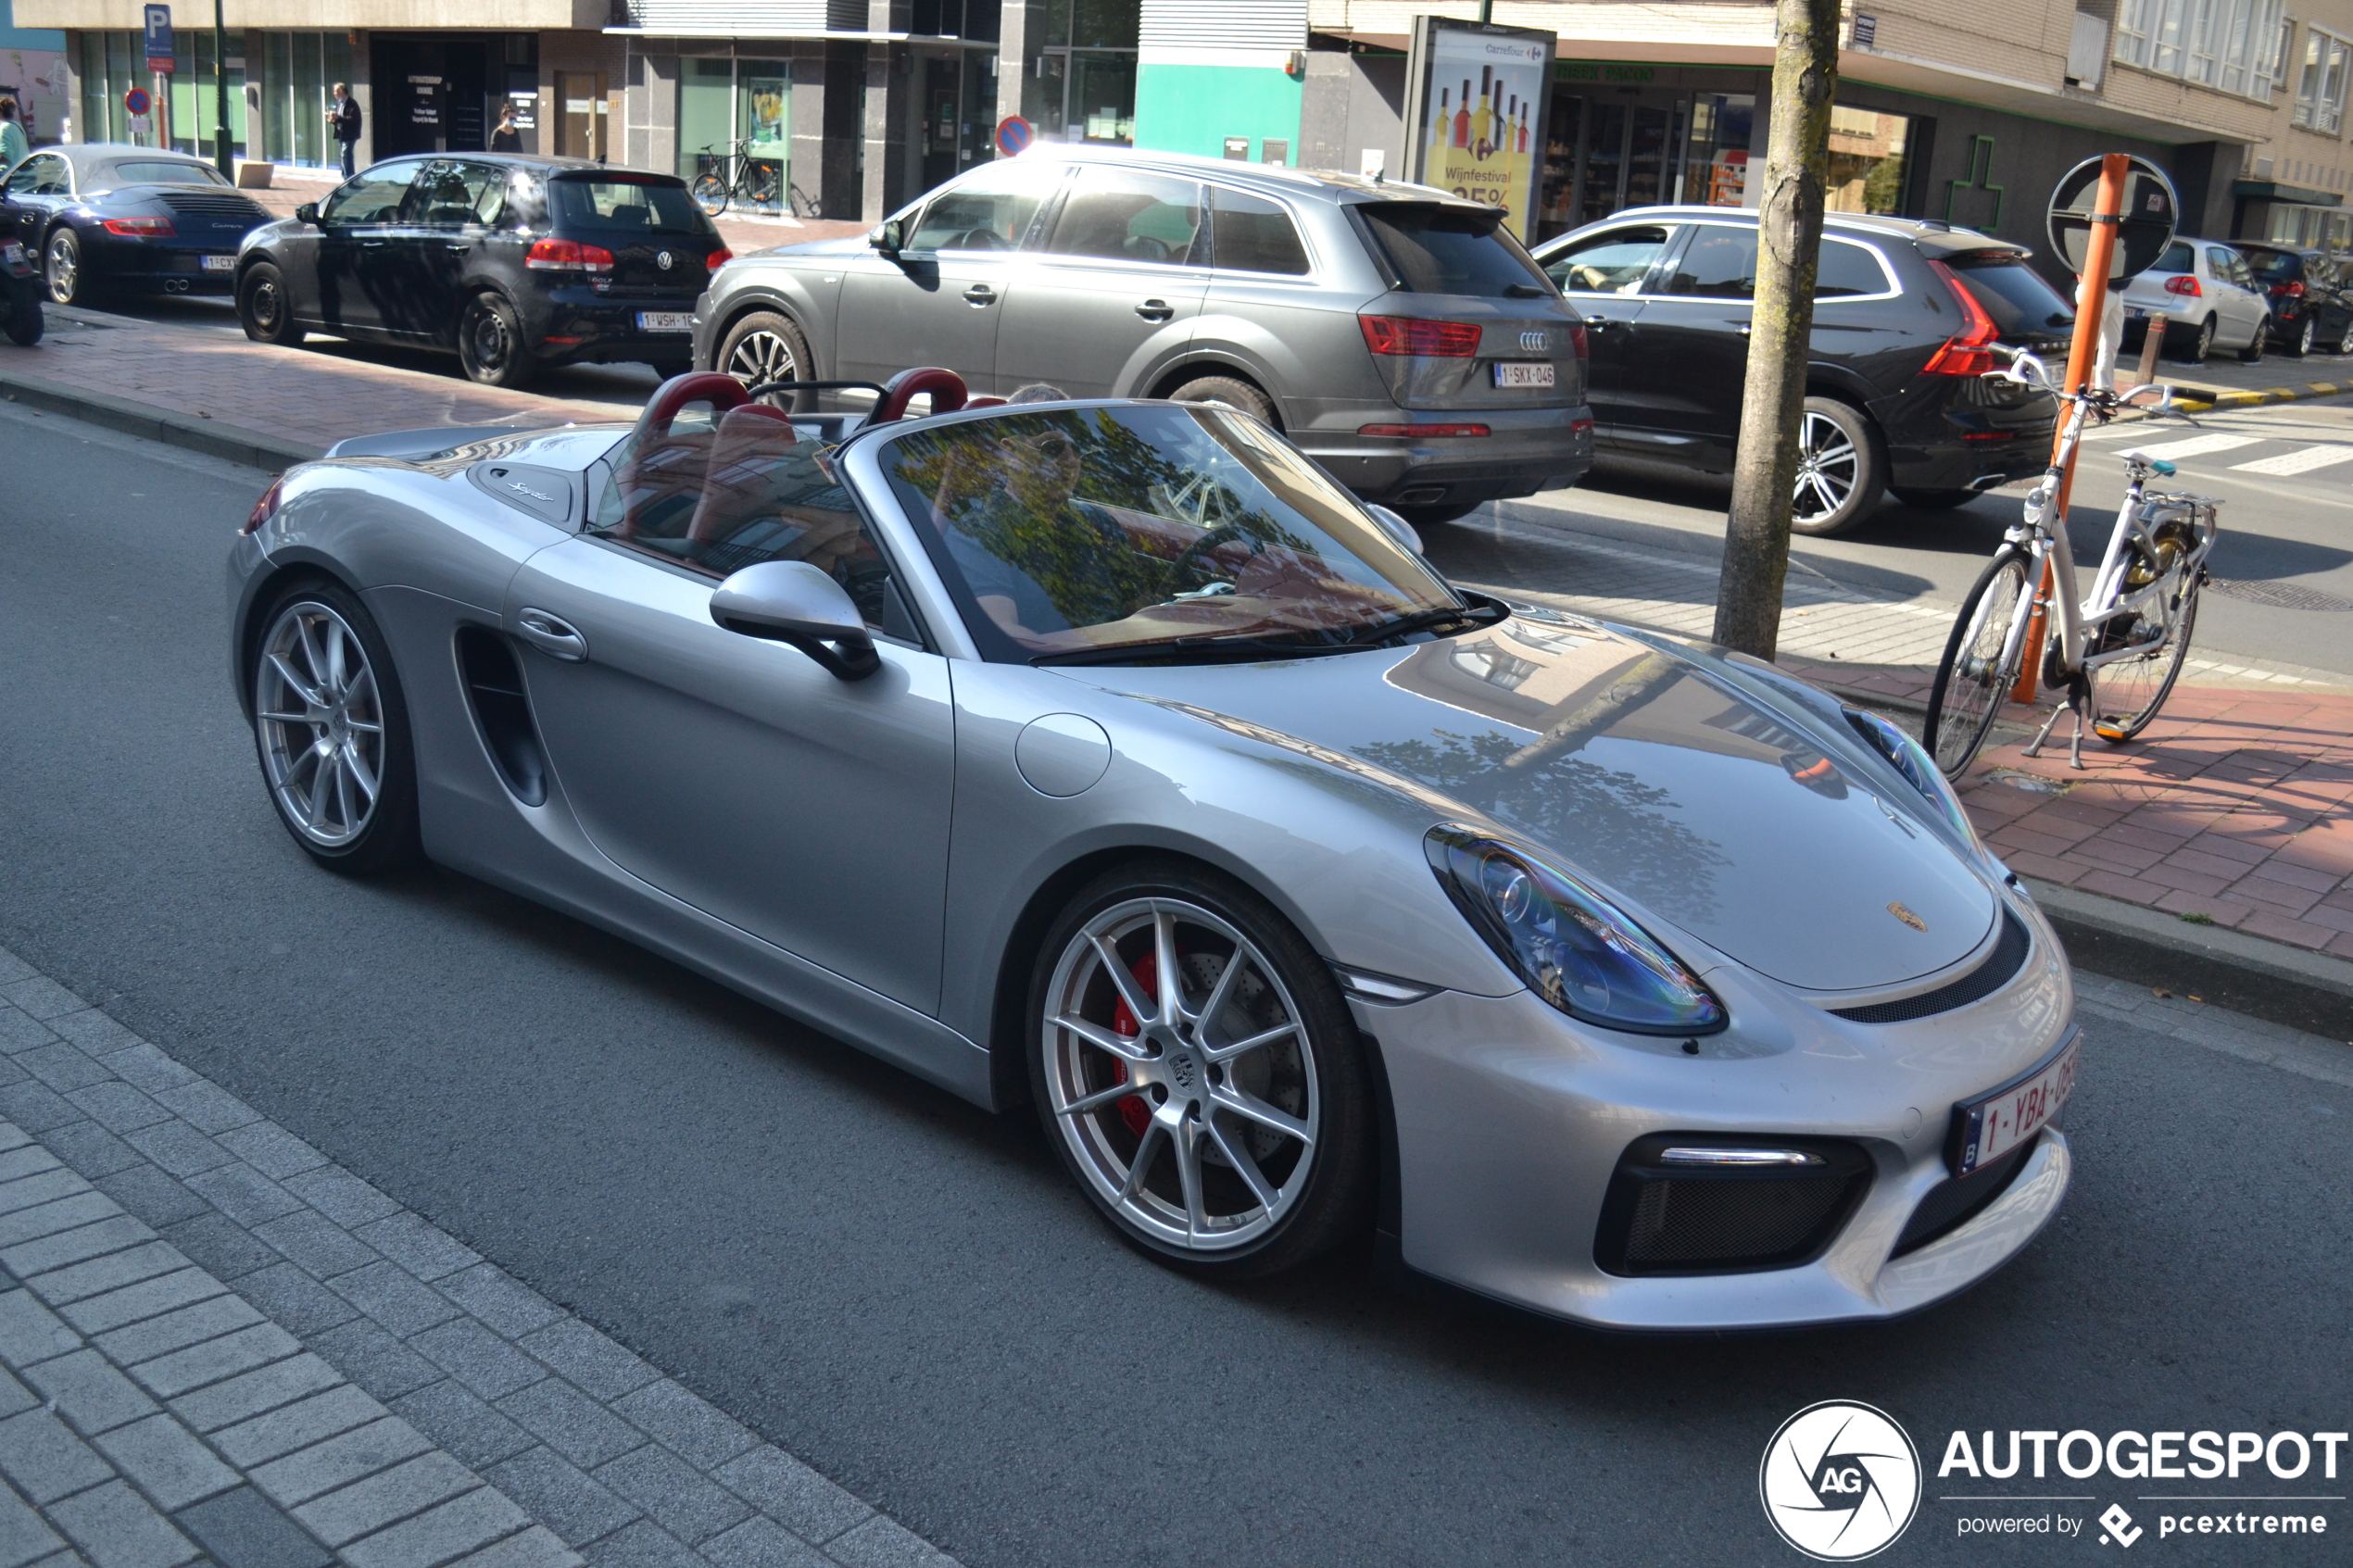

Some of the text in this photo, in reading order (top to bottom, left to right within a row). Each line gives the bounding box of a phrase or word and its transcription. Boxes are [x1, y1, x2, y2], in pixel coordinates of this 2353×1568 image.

[148, 10, 168, 38] P
[1486, 44, 1523, 56] Carrefour
[1445, 167, 1511, 183] Wijnfestival
[1503, 367, 1553, 383] 1-SKX-046
[507, 483, 554, 502] Spyder
[1965, 1143, 1976, 1165] B
